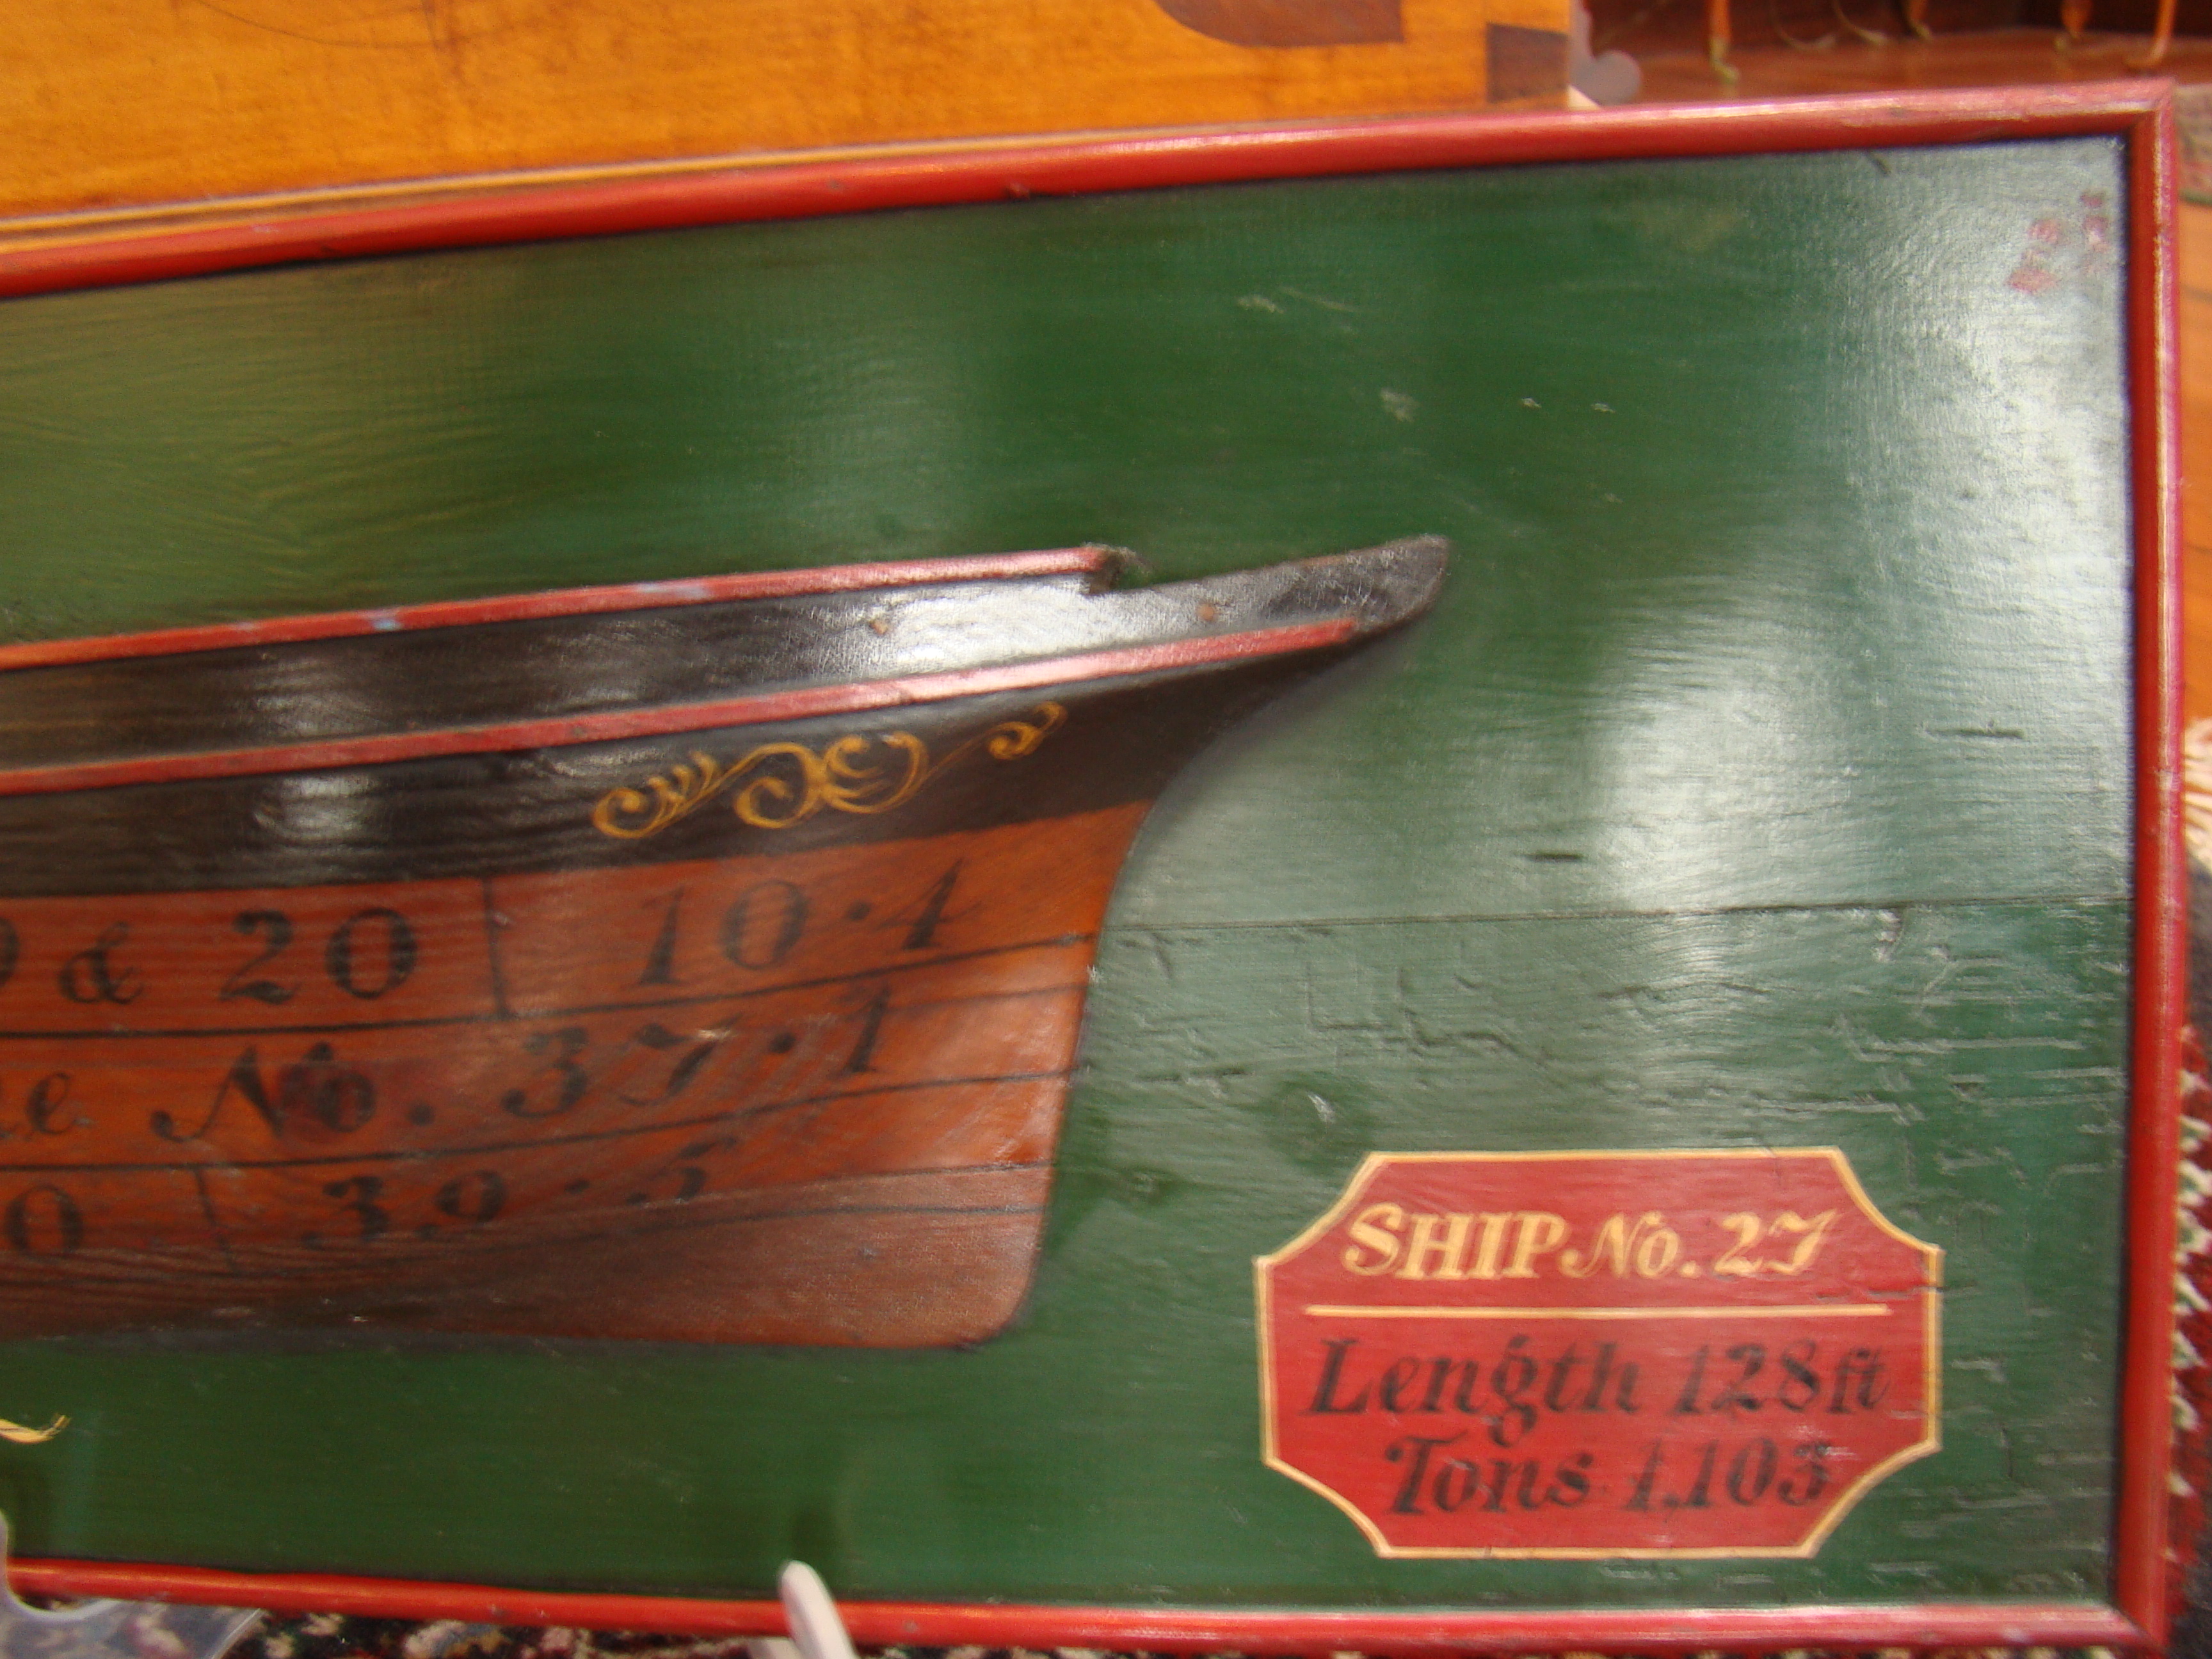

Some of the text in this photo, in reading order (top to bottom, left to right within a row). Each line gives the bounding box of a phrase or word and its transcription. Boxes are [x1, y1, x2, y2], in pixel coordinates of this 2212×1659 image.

[219, 907, 419, 1005] 20
[1343, 1202, 1839, 1280] SHIP No. 27
[1304, 1334, 1640, 1448] Length
[1386, 1431, 1594, 1515] Tons
